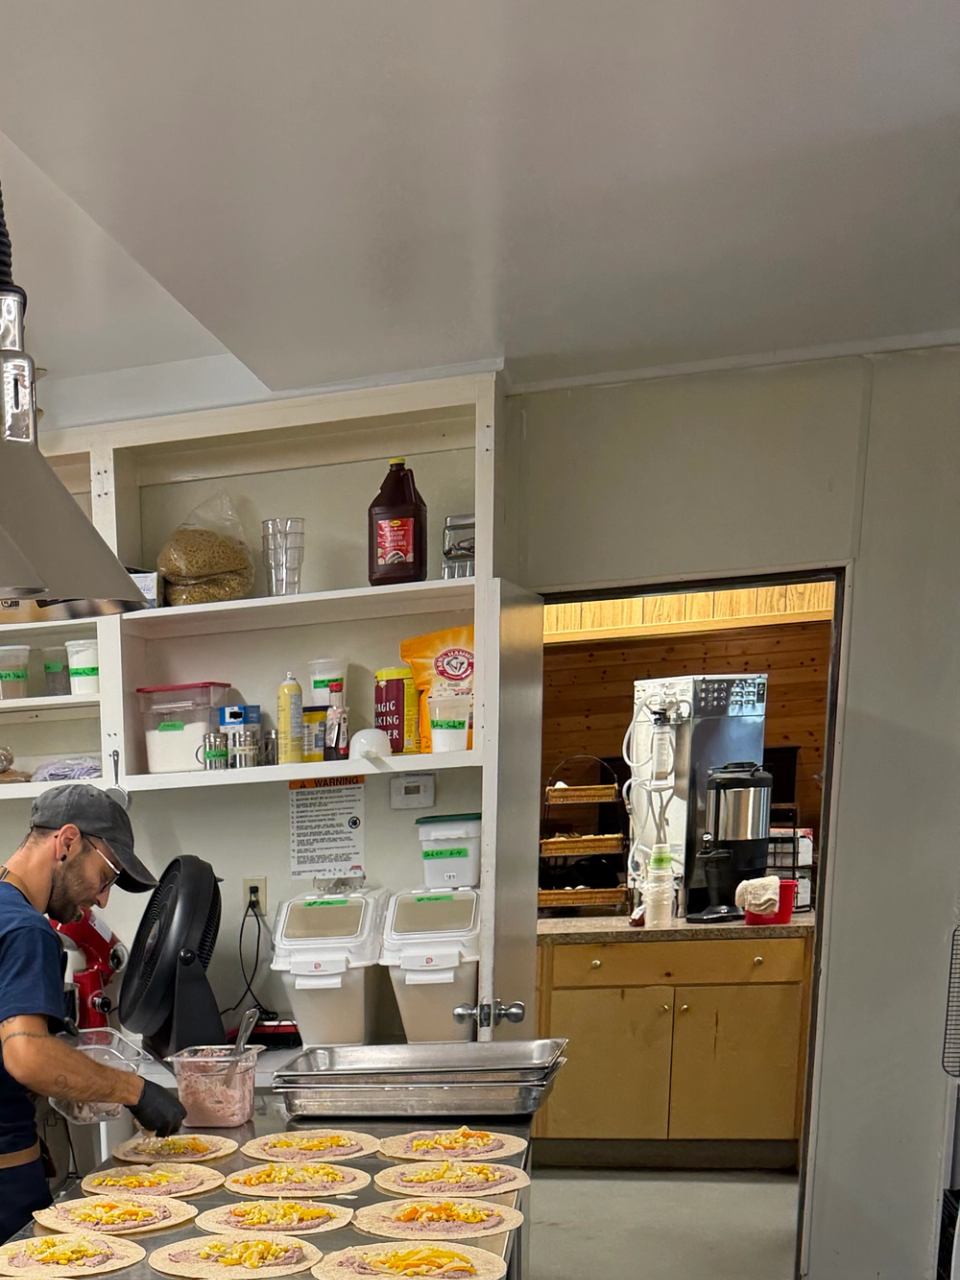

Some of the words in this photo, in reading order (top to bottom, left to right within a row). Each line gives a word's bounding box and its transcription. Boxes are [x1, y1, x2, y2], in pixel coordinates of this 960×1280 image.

[374, 700, 396, 713] AGIC
[374, 714, 400, 727] AKING
[314, 775, 359, 788] WARNING
